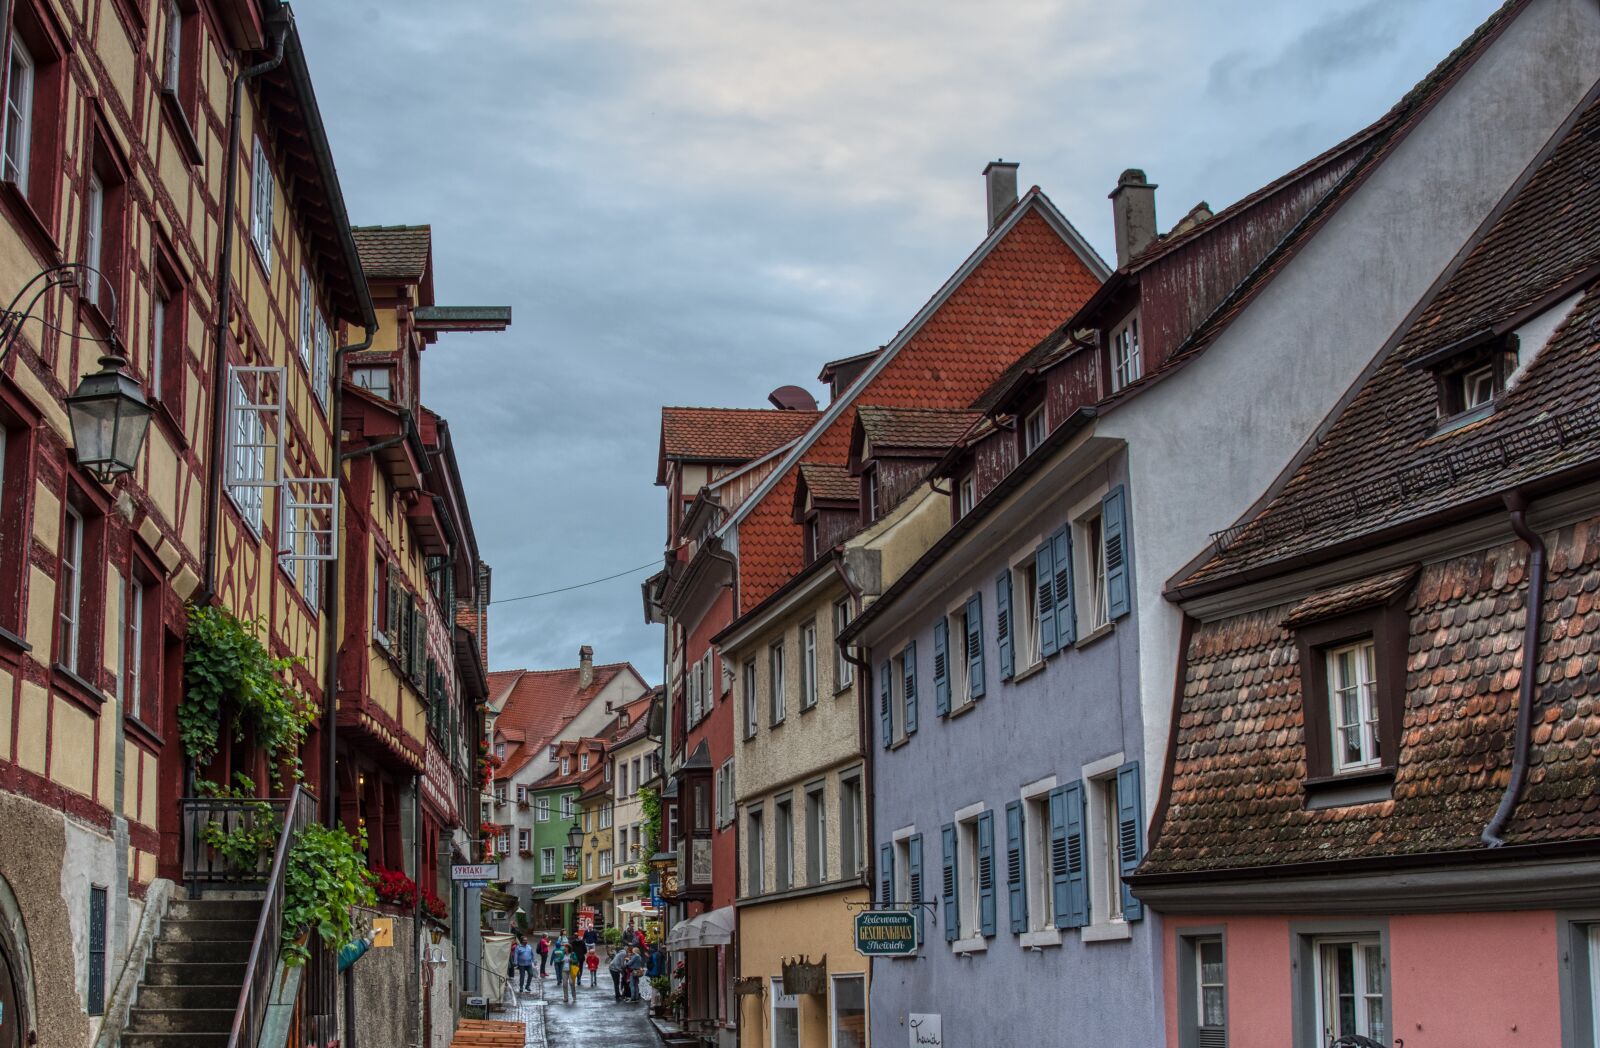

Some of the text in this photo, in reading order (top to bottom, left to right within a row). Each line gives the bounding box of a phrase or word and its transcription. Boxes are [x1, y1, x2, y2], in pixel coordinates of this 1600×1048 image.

[454, 866, 482, 875] SYRTAKI
[863, 914, 909, 925] Lederwaren
[859, 925, 912, 940] GESCHENKHAUS
